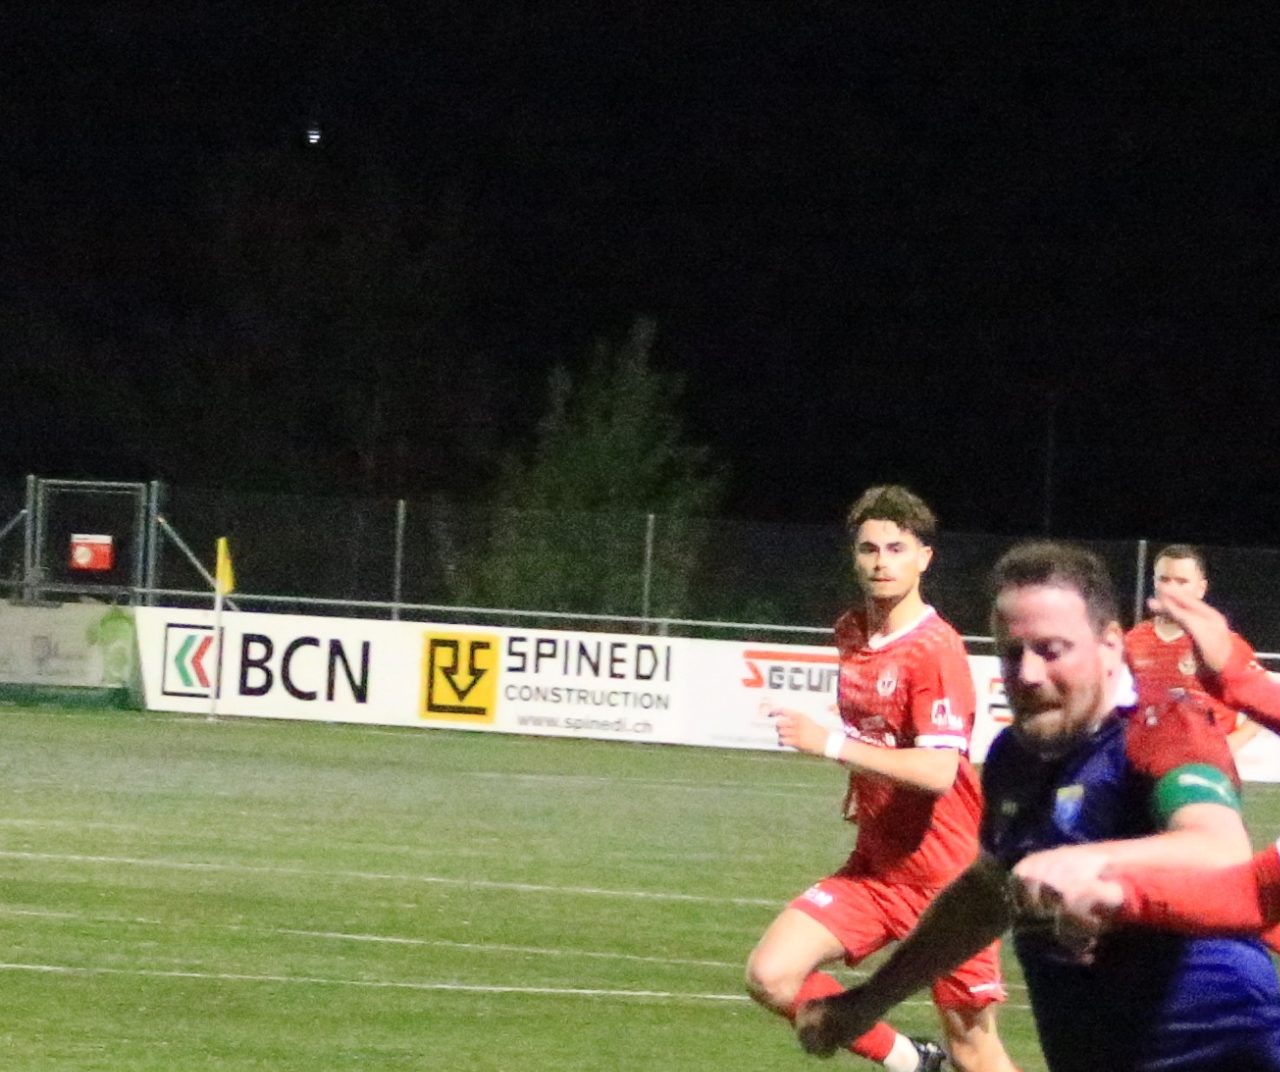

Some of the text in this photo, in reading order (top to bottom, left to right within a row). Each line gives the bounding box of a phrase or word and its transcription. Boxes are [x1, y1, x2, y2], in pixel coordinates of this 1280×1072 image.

[238, 632, 371, 704] BCN
[506, 636, 672, 682] SPINEDI
[504, 684, 670, 710] CONSTRUCTION
[516, 713, 654, 734] www.spinedi.ch
